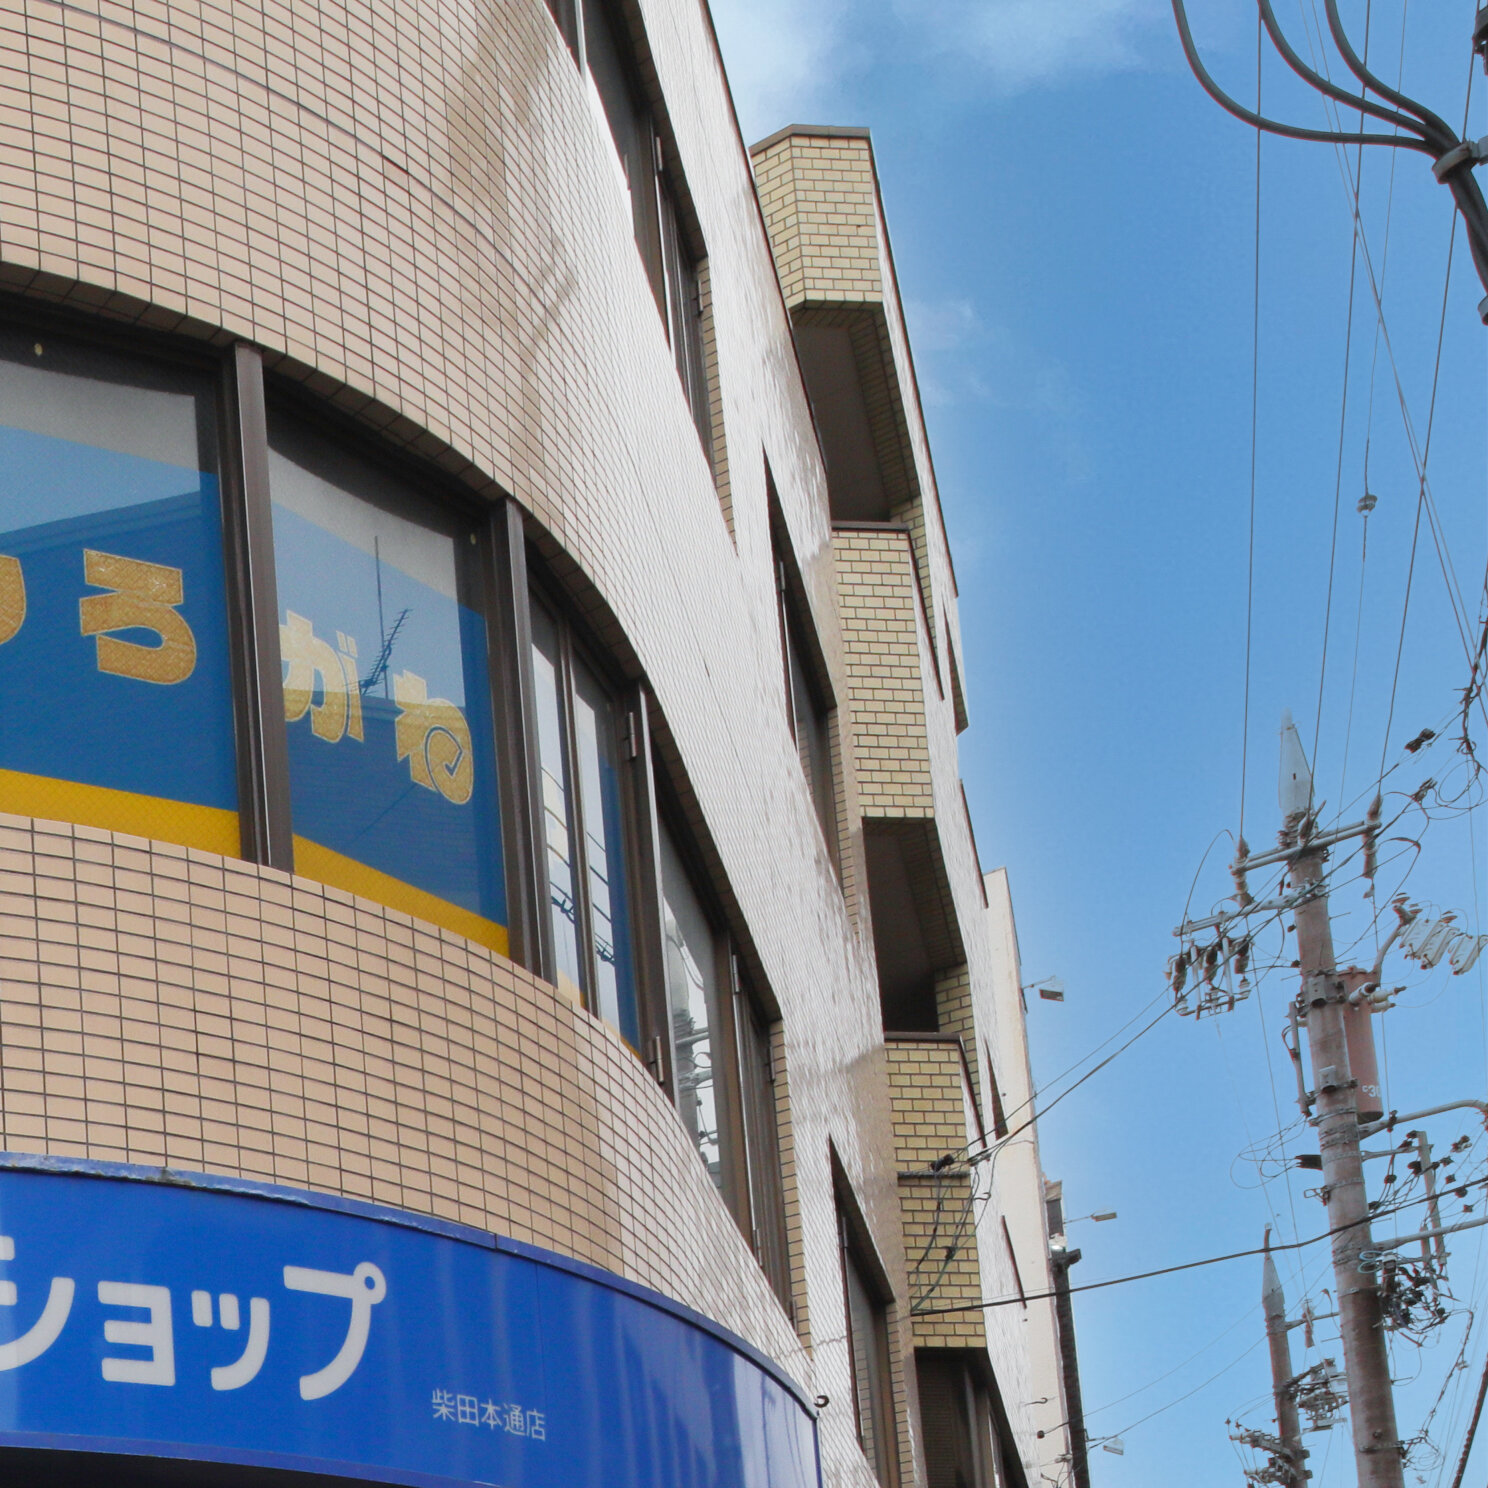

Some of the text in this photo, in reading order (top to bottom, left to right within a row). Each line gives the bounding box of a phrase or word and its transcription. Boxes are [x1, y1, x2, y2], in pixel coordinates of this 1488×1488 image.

[431, 1388, 547, 1443] 柴田本通店
